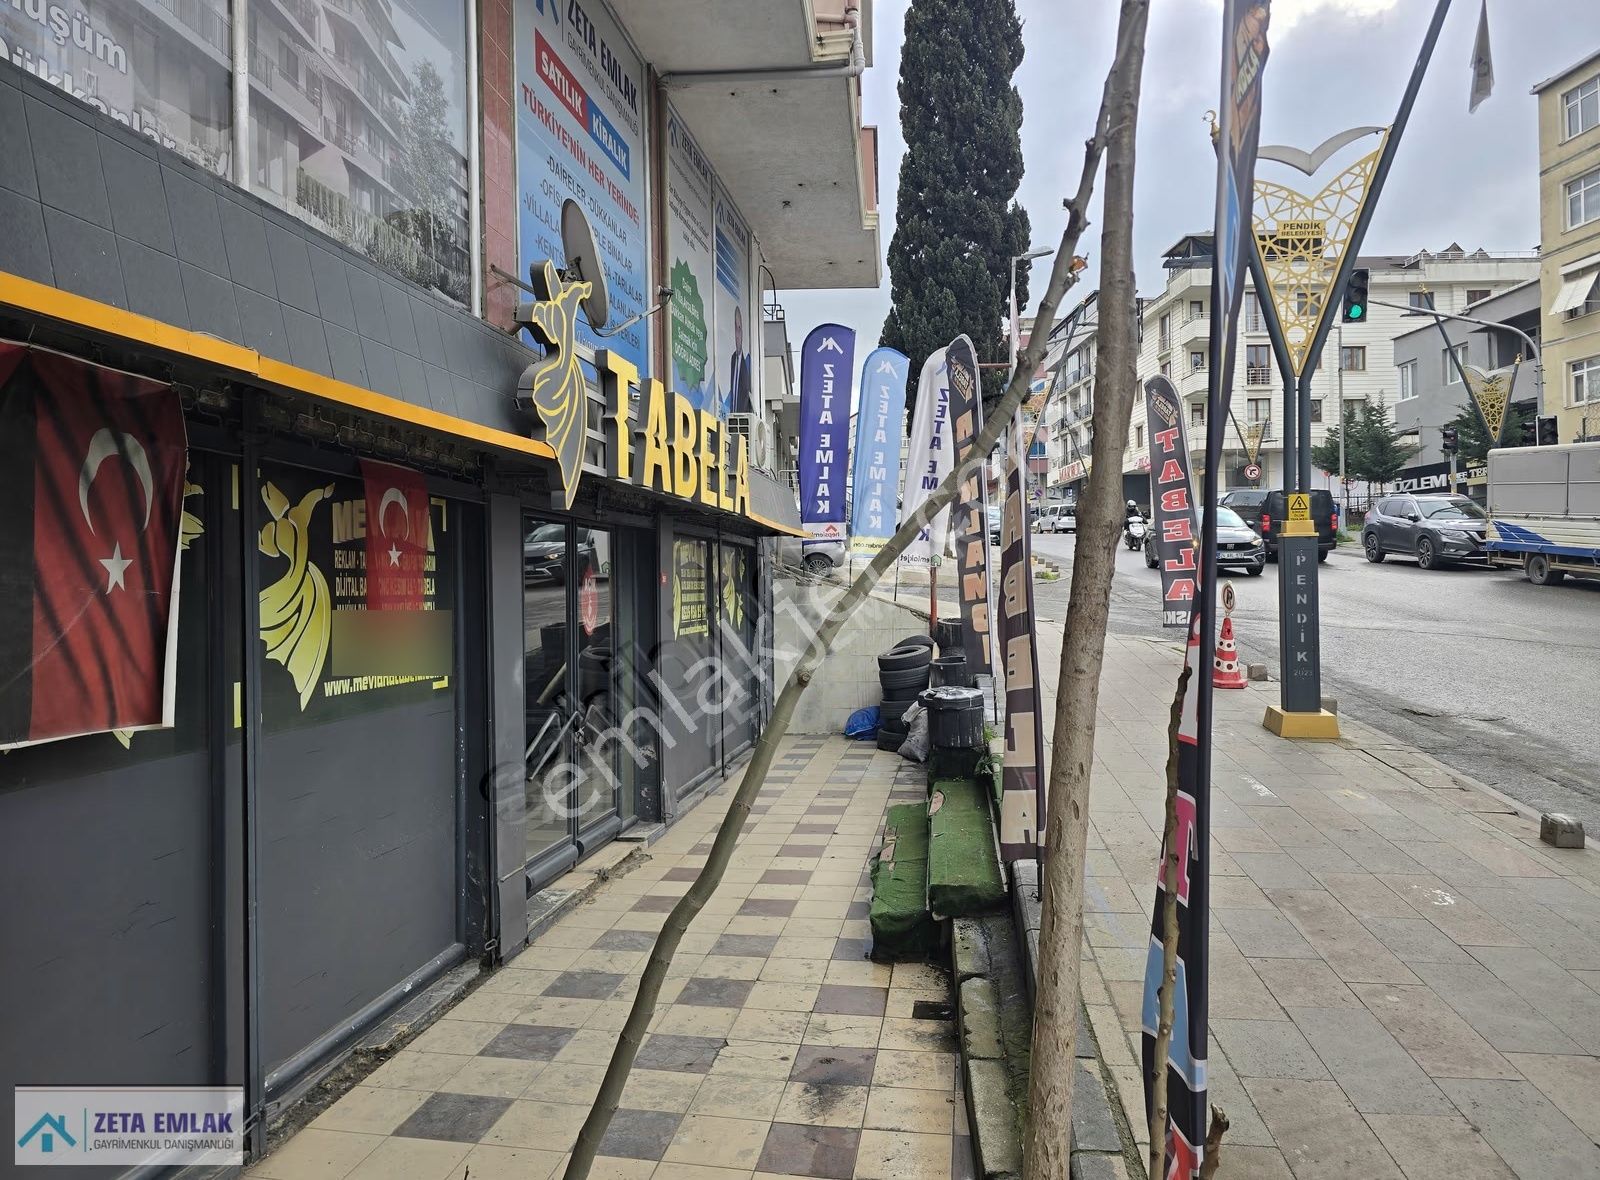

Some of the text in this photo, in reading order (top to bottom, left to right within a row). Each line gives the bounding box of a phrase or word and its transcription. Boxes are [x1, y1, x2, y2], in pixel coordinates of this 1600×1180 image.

[541, 50, 628, 171] SATILIK KİRALIK
[601, 38, 638, 116] EMLAK
[521, 82, 587, 169] TÜRKİYE'NİN
[588, 157, 605, 190] HER
[1283, 220, 1321, 230] PENDİK
[603, 349, 751, 517] TABELA
[1393, 473, 1448, 494] ÖZLEM
[335, 572, 359, 597] DİJİTAL
[1296, 555, 1308, 662] PENDİK
